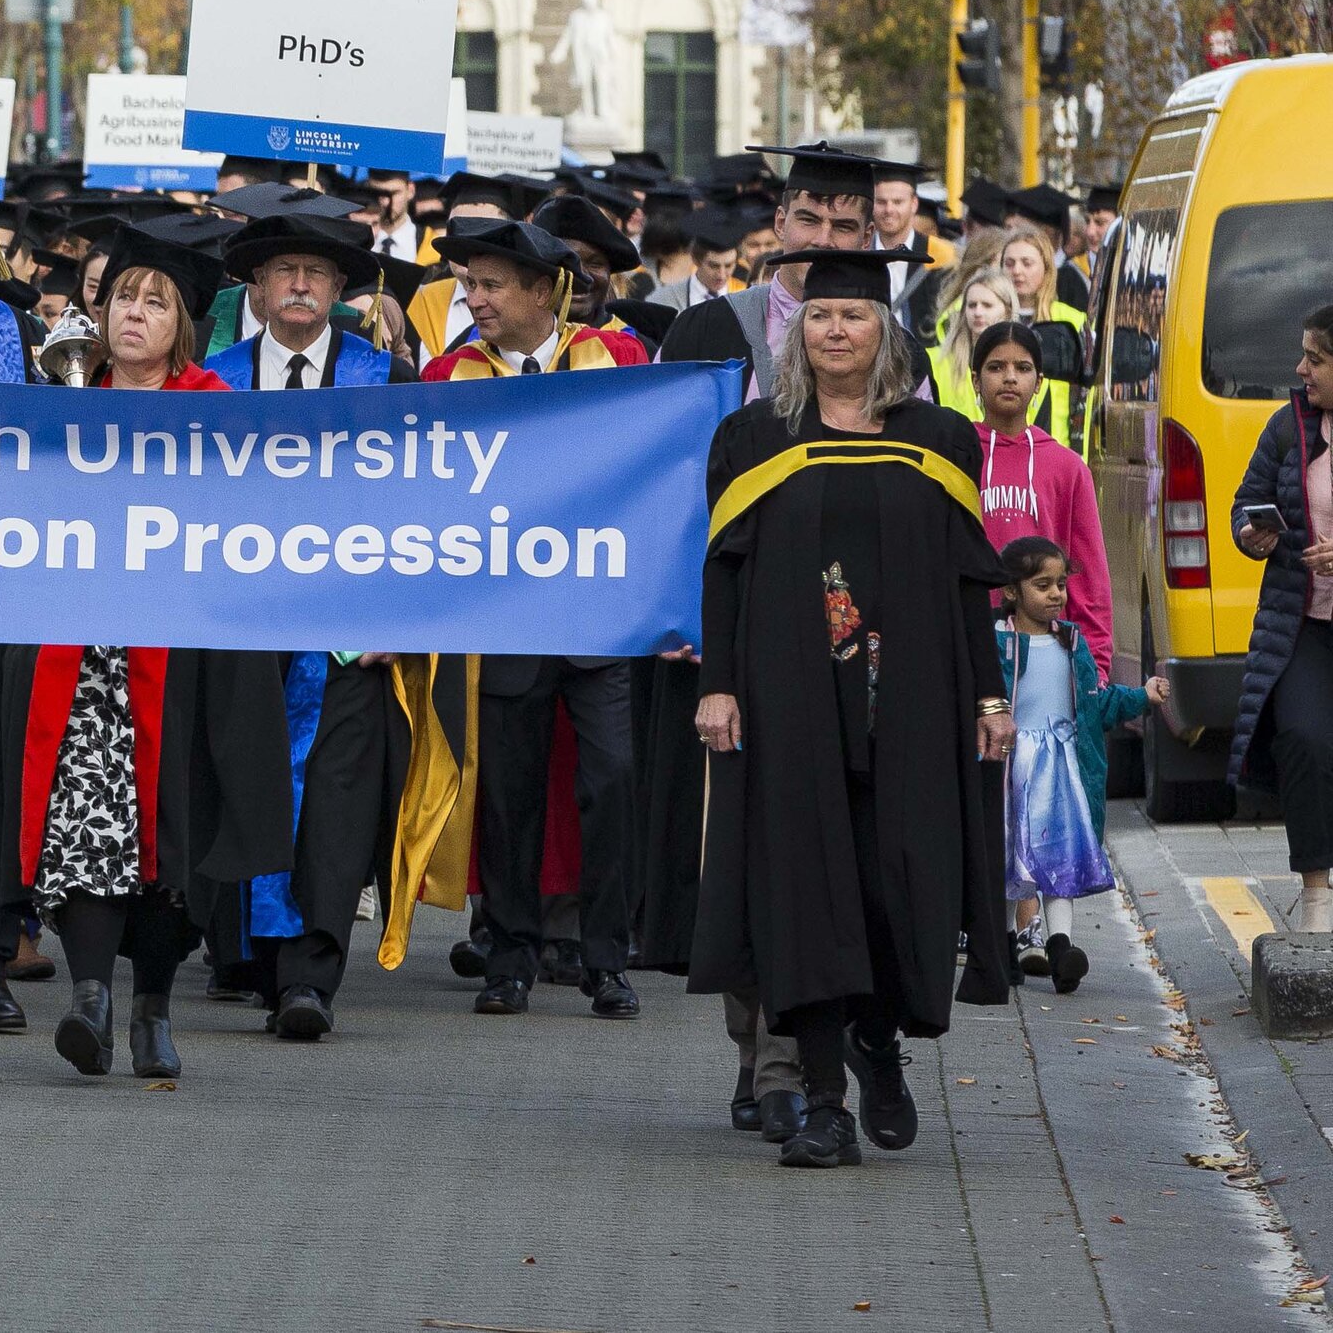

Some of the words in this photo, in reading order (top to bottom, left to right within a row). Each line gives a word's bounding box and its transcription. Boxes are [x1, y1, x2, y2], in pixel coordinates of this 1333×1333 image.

[277, 34, 366, 68] PhD's
[123, 95, 184, 108] Bachelo
[99, 114, 182, 128] Agribusine
[105, 132, 142, 146] Food
[295, 130, 341, 141] LINCOLN
[295, 138, 360, 150] UNIVERSITY
[65, 413, 510, 495] University
[124, 505, 627, 578] Procession
